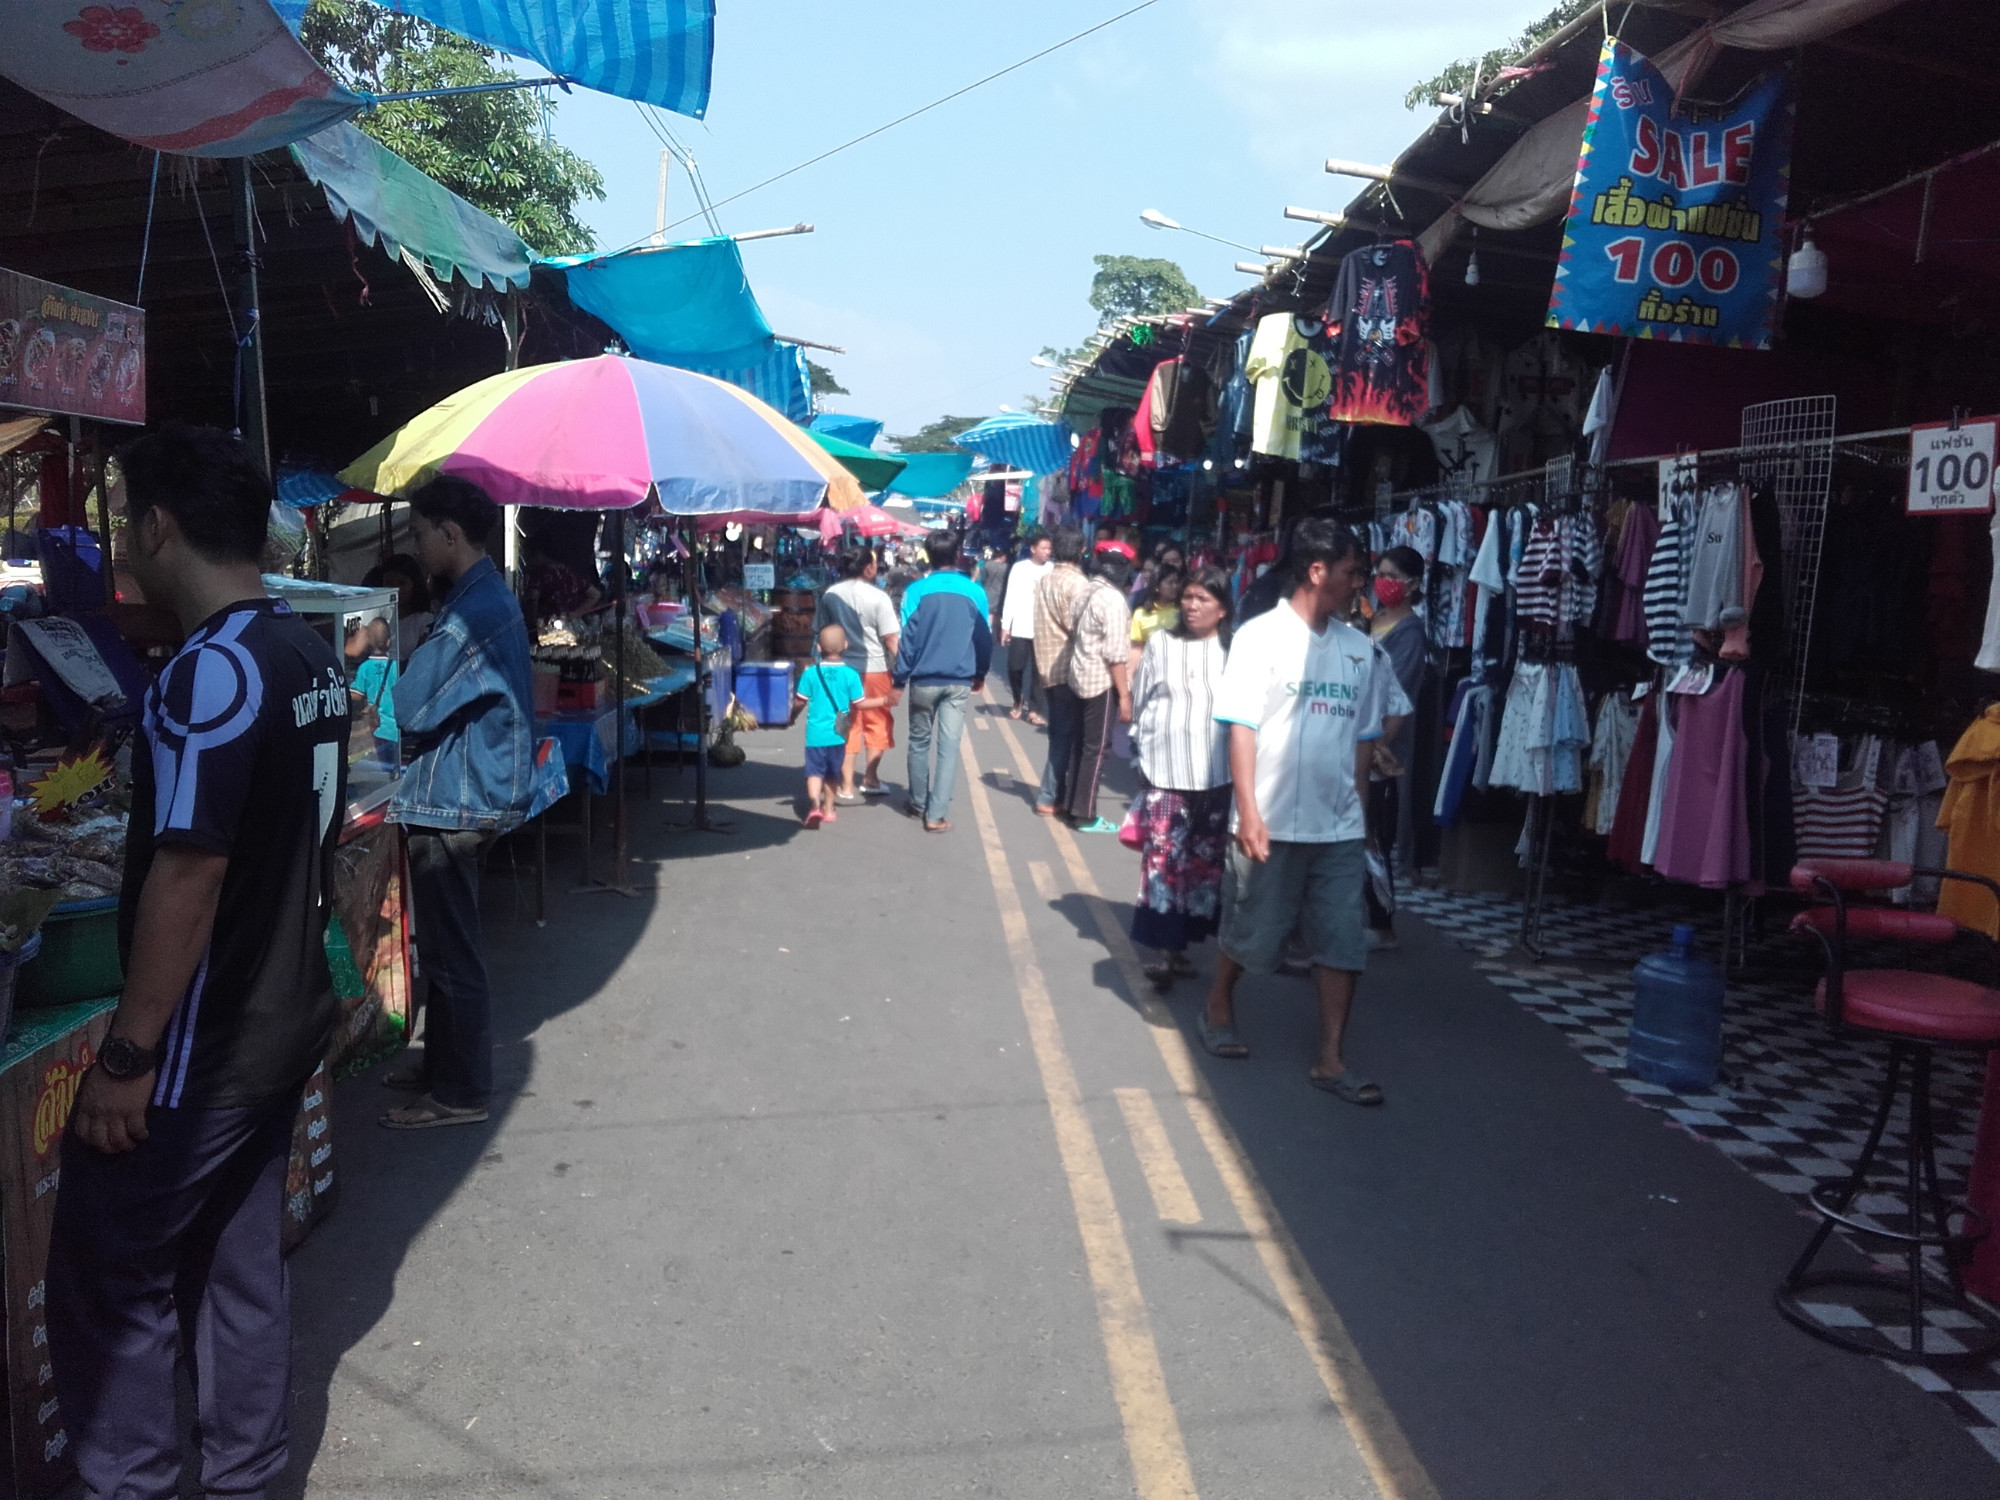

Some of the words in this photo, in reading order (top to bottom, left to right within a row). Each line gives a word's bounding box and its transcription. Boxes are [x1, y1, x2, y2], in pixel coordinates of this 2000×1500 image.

[1629, 114, 1754, 191] SALE
[1604, 236, 1739, 294] 100
[1637, 288, 1720, 328] ทั้งร้าน
[1915, 451, 1989, 493] 100
[1930, 491, 1966, 509] ทุกตัว
